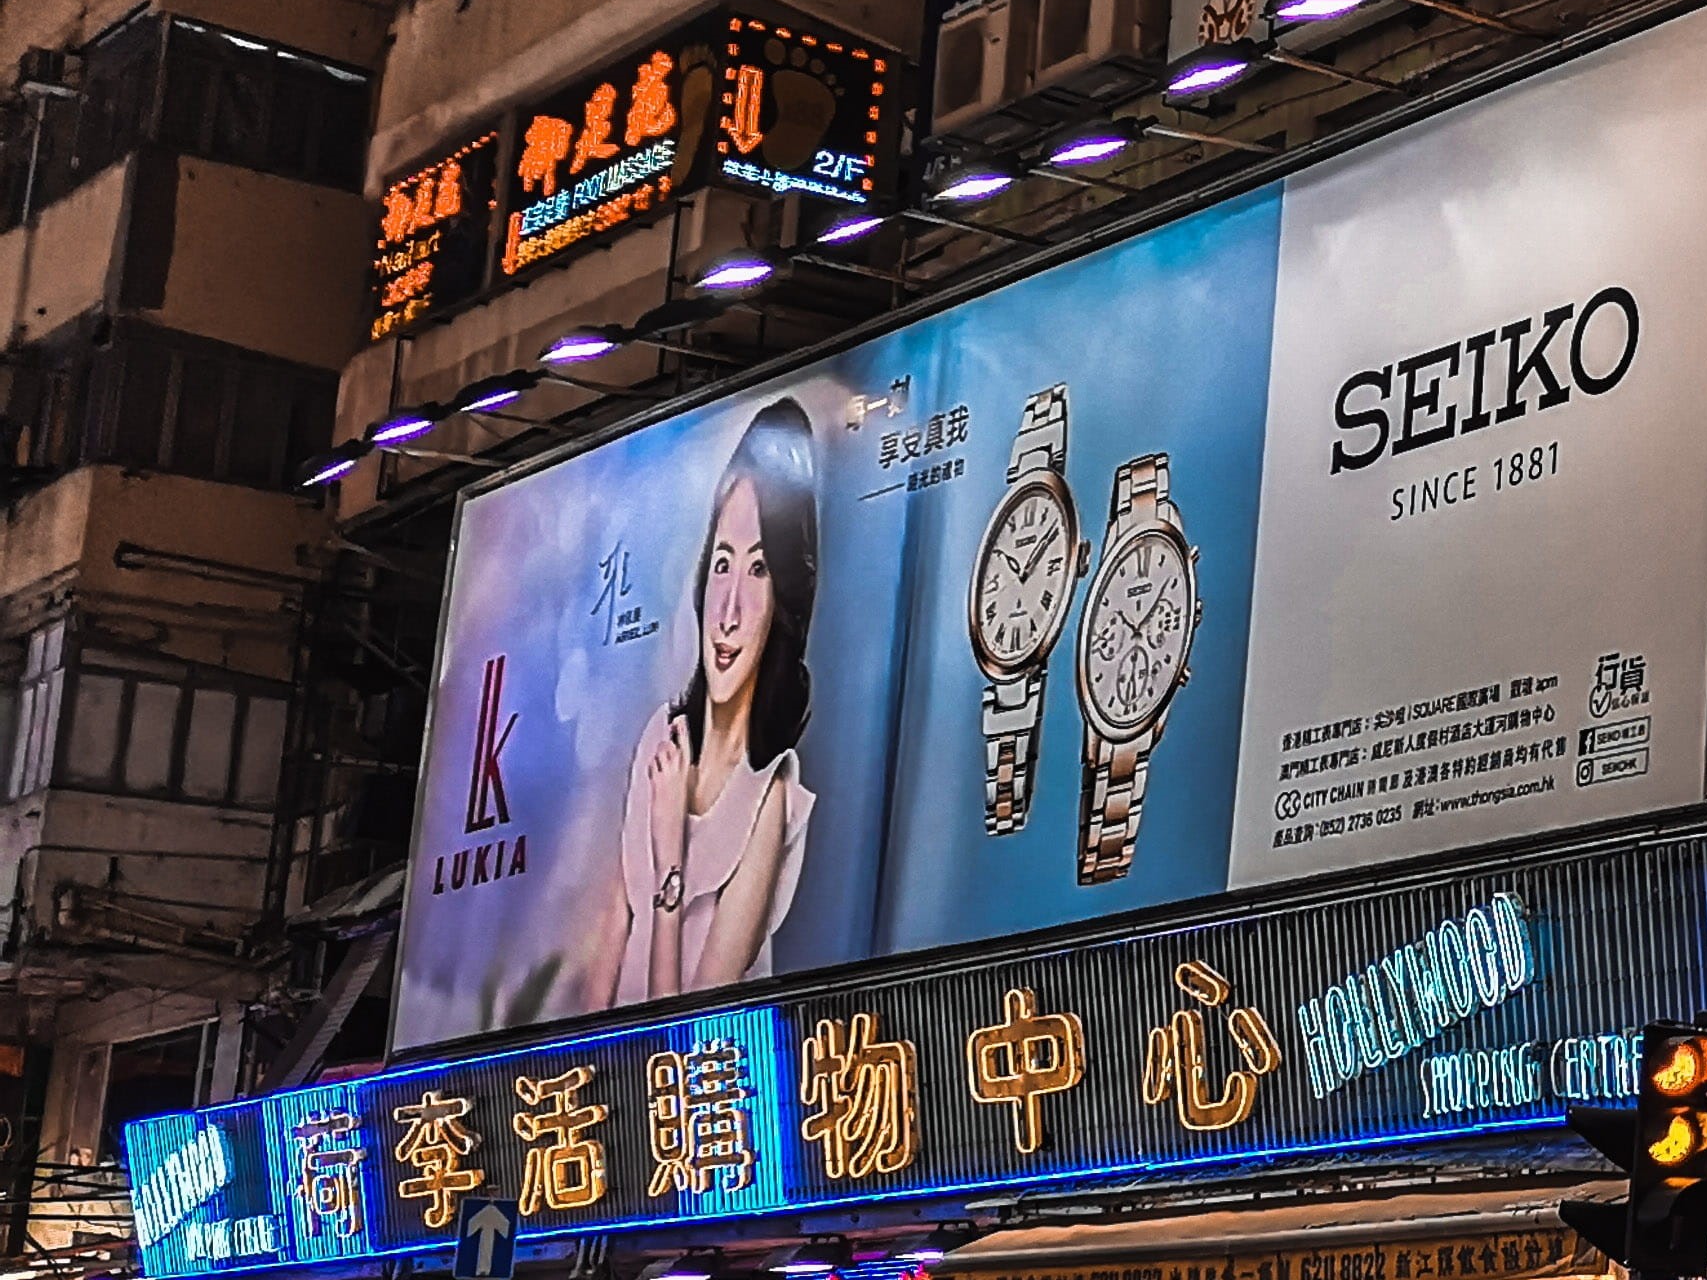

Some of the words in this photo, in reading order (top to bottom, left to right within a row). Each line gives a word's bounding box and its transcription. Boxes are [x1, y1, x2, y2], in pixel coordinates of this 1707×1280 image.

[813, 151, 866, 180] 2/F
[1330, 286, 1640, 475] SEIKO
[1391, 466, 1477, 521] SINCE
[1493, 442, 1559, 490] 1881
[1304, 790, 1328, 810] CITY
[1330, 781, 1364, 804] CHAIN
[1376, 803, 1402, 826] 0235
[433, 835, 527, 895] LUKIA
[1299, 892, 1533, 1099] HOLLYWOOD
[295, 961, 1279, 1242] 荷李活購物中心
[1422, 1041, 1539, 1118] SHOPPING
